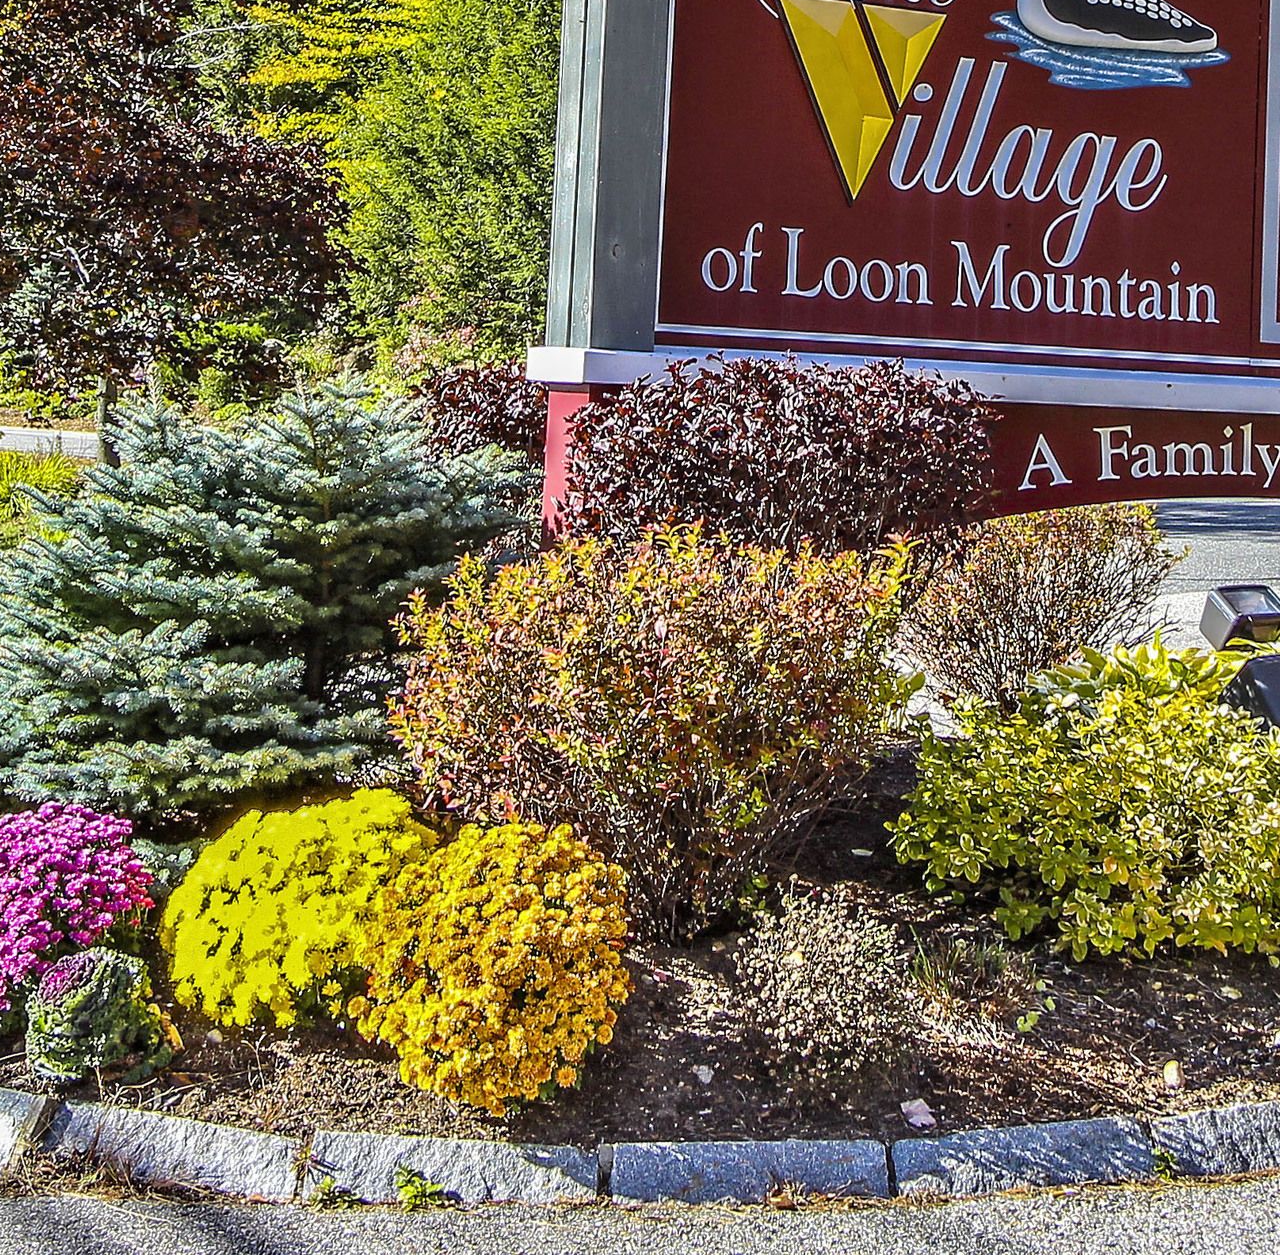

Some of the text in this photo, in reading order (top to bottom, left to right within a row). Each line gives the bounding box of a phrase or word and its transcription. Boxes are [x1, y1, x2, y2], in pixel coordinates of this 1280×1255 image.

[700, 222, 1220, 323] of Loon Mountain
[1017, 433, 1072, 492] A
